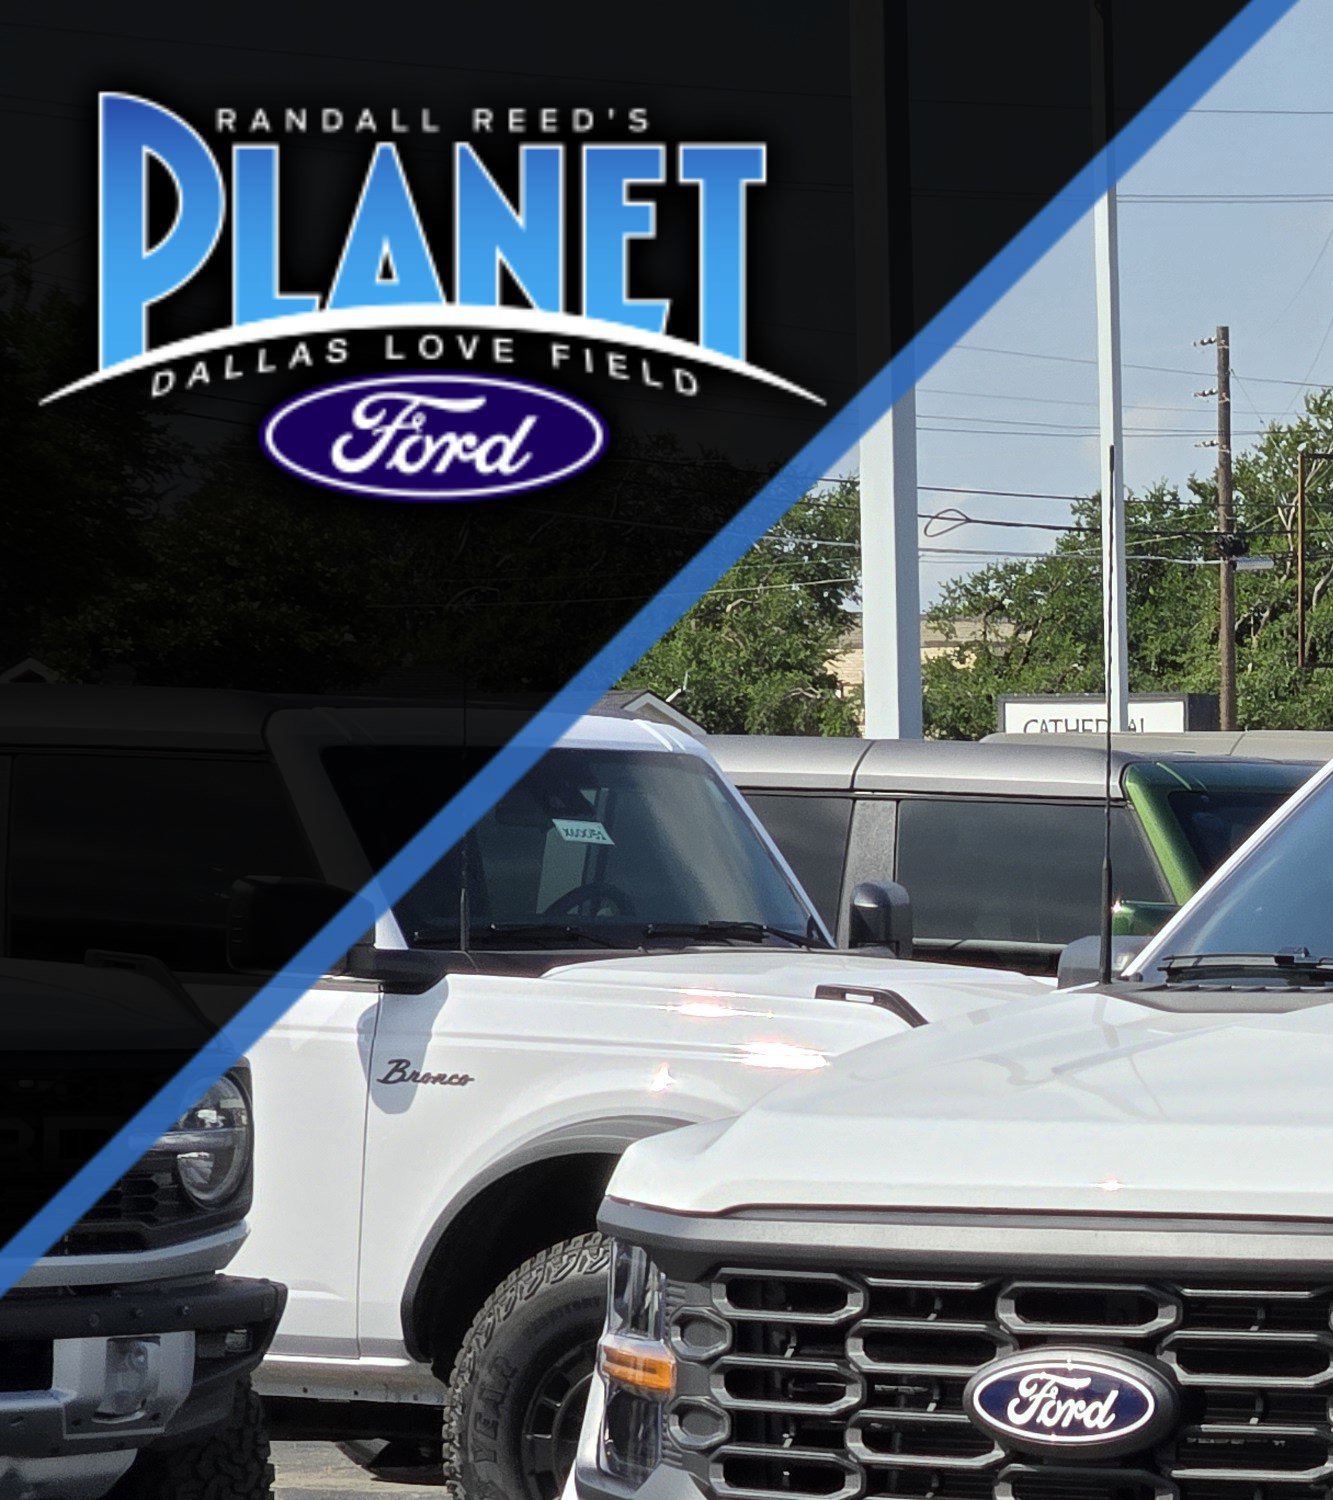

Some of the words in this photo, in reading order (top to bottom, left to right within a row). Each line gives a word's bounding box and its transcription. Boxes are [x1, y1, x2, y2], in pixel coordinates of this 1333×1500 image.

[1023, 718, 1145, 733] CATHEAL
[376, 1058, 475, 1086] Bronco
[1006, 1372, 1119, 1429] Ford
